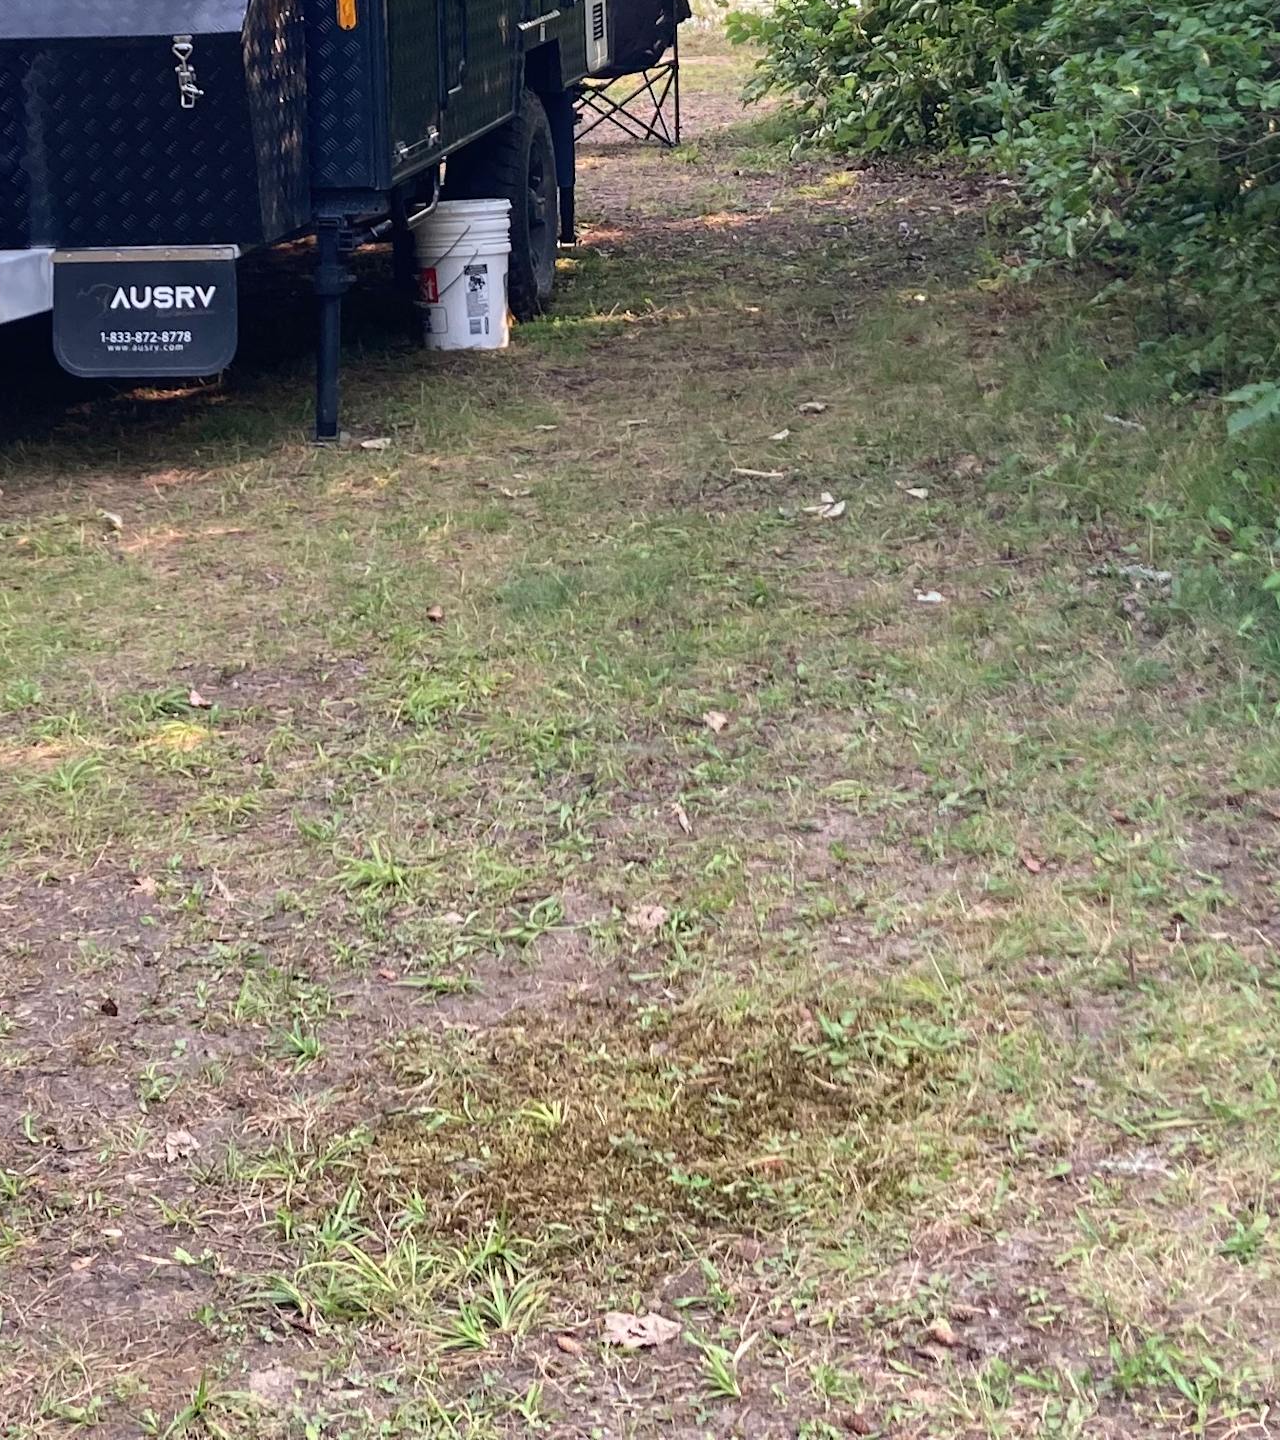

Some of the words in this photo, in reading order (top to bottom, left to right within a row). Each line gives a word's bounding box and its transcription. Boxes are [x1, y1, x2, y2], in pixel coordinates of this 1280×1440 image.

[110, 286, 216, 309] AUSRV
[100, 331, 192, 343] 1-833-872-8778
[107, 343, 183, 353] www.ausrv.com
